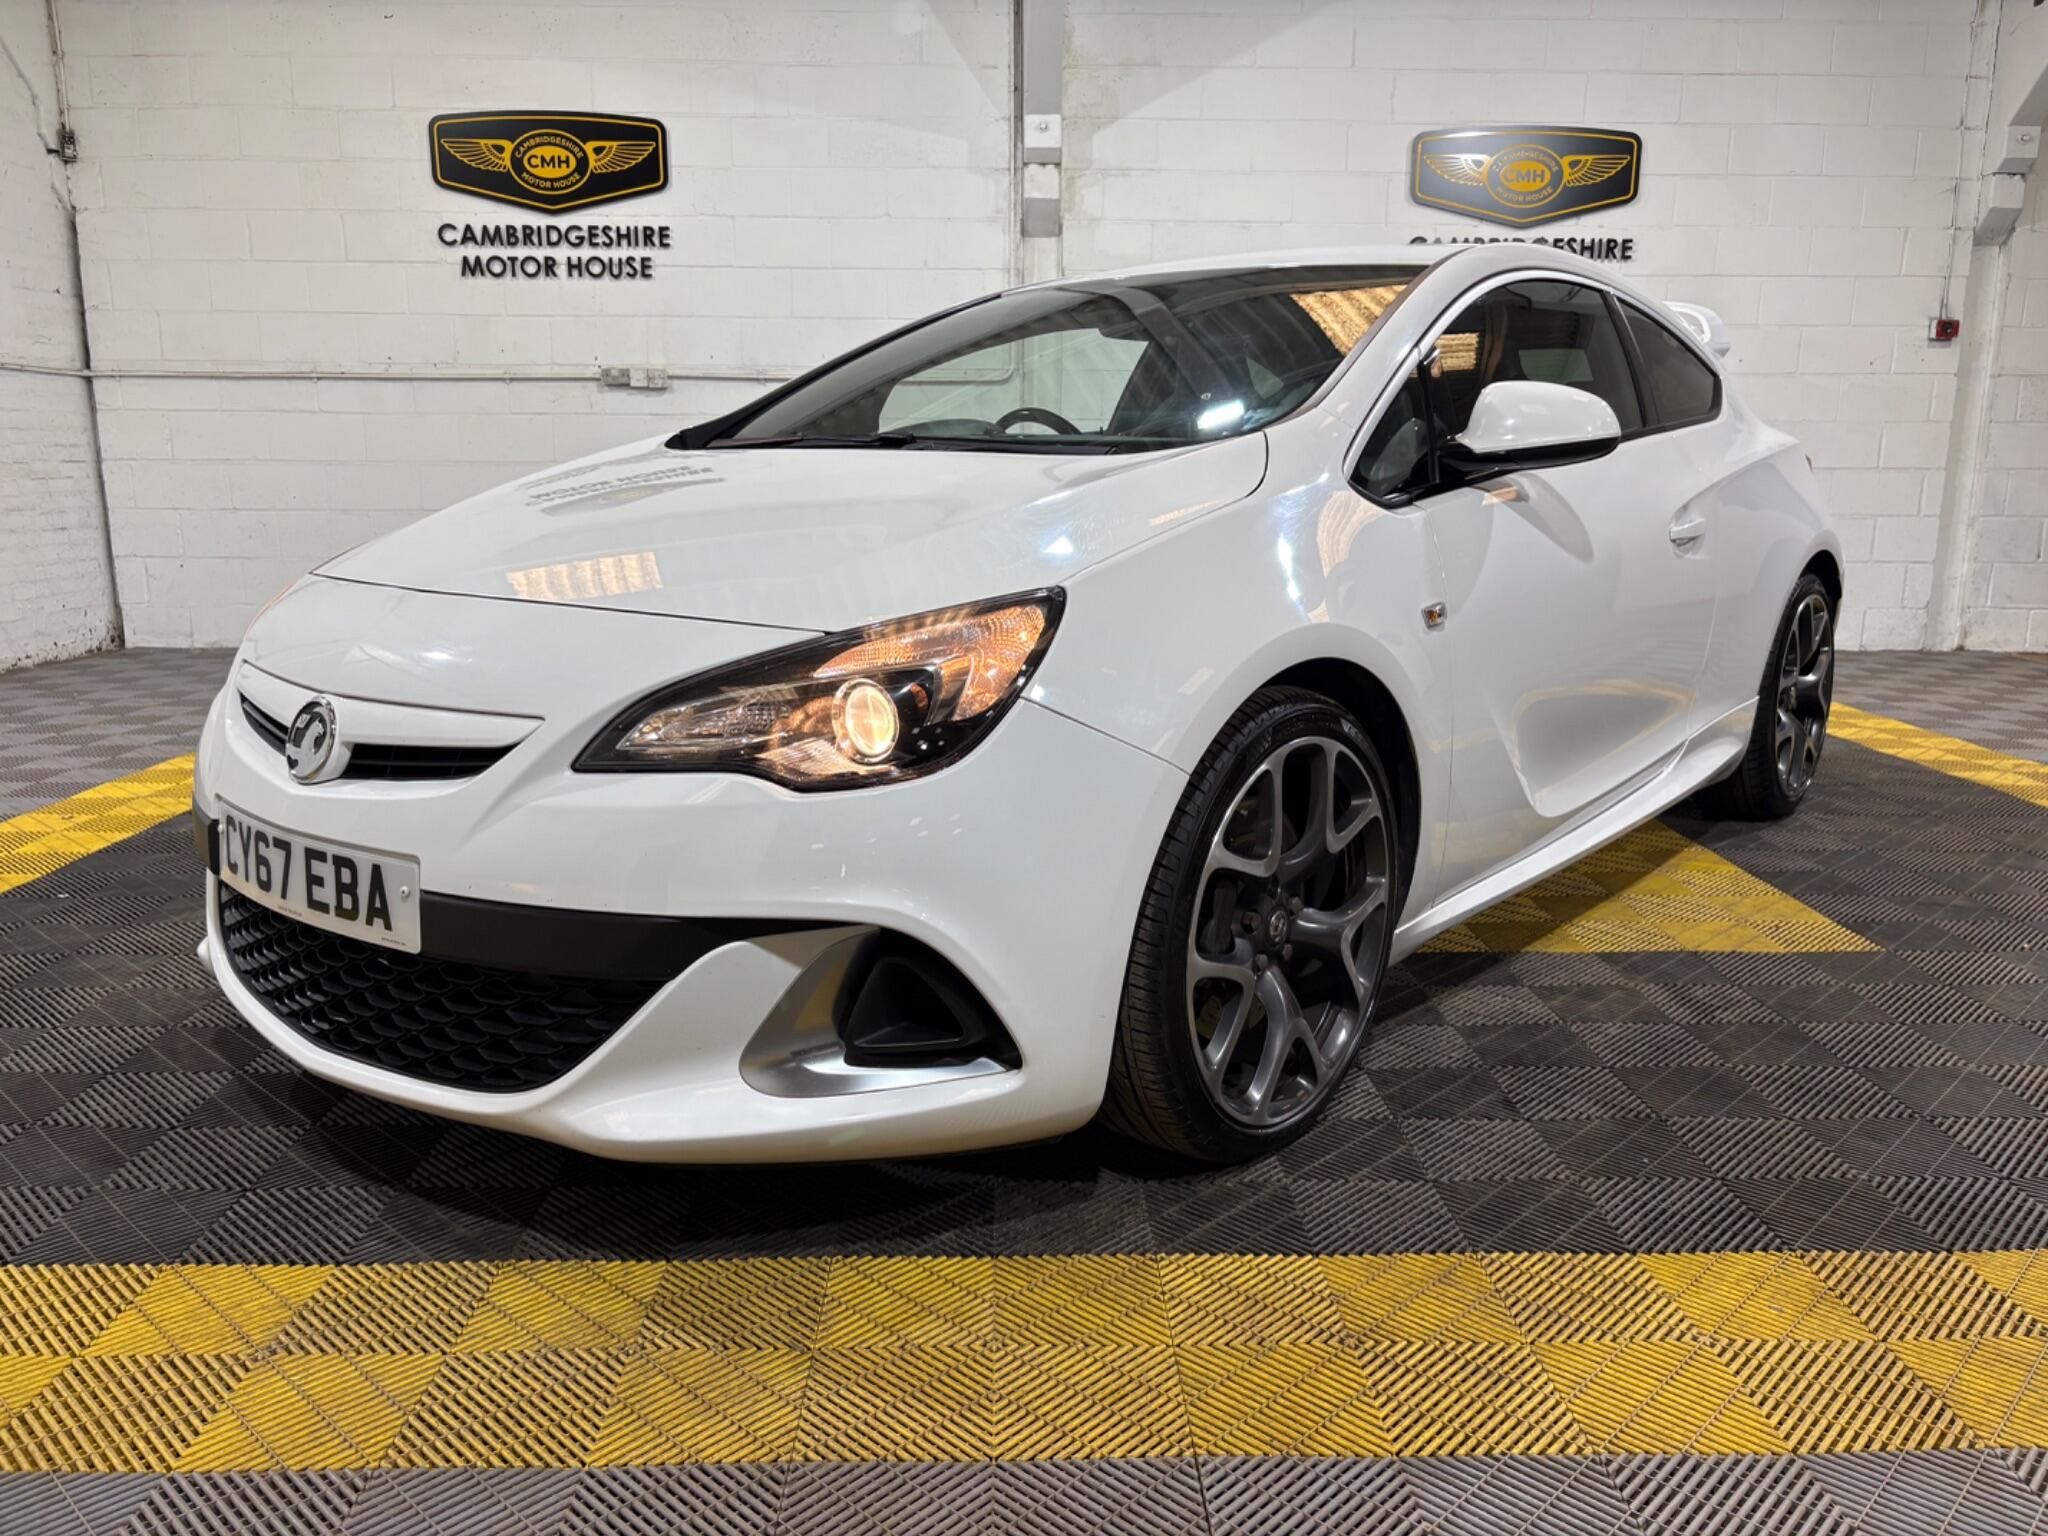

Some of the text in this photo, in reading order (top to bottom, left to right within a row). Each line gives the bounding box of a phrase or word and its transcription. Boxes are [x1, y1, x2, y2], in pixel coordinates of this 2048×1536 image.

[515, 136, 584, 159] CAMBRIDGESHIRE
[527, 154, 570, 169] CMH
[521, 172, 581, 188] MOTOR HOUSE
[1504, 169, 1545, 183] CMH
[437, 223, 671, 248] CAMBRIDGESHIRE
[461, 255, 653, 280] MOTOR HOUSE
[225, 814, 393, 932] CY67 EBA
